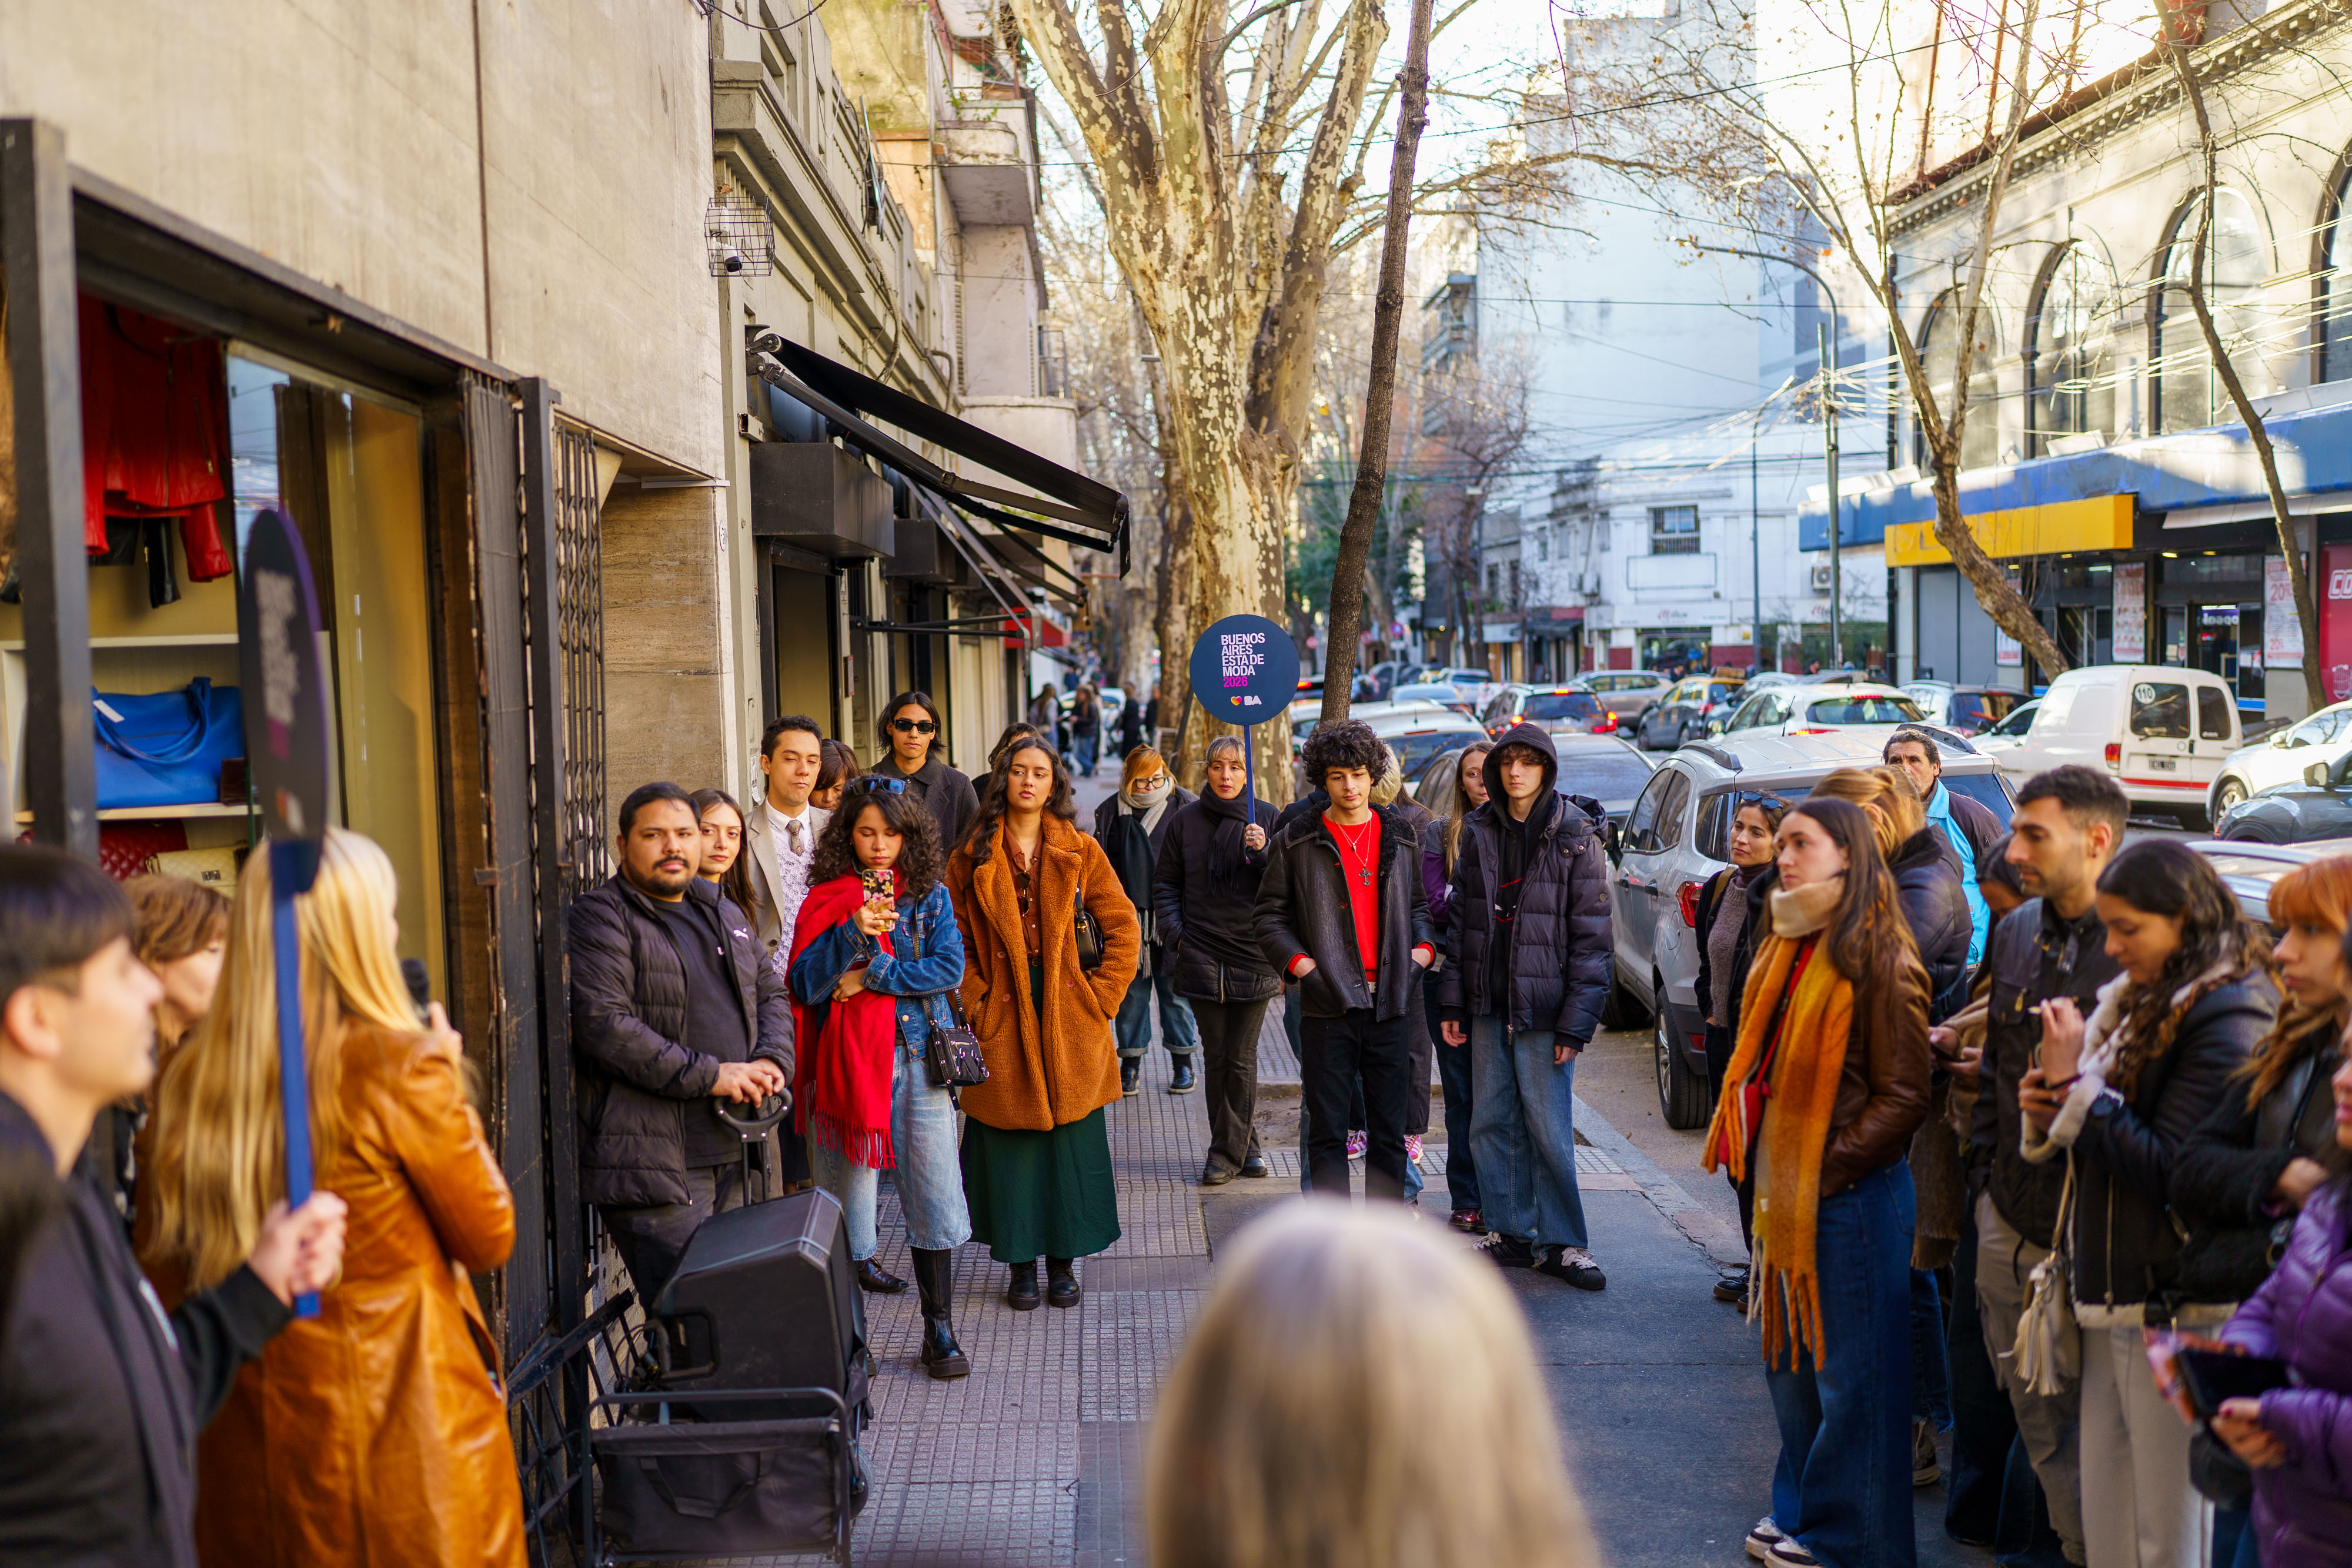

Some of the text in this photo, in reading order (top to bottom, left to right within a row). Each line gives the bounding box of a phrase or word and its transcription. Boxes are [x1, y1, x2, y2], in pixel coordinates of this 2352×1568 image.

[1221, 633, 1265, 645] BUENOS
[1221, 644, 1253, 656] AIRES
[1222, 654, 1265, 666] ESTA DE
[1222, 665, 1255, 677] MODA
[1223, 676, 1248, 687] 2026
[2137, 687, 2153, 699] 110
[1244, 695, 1262, 706] BA
